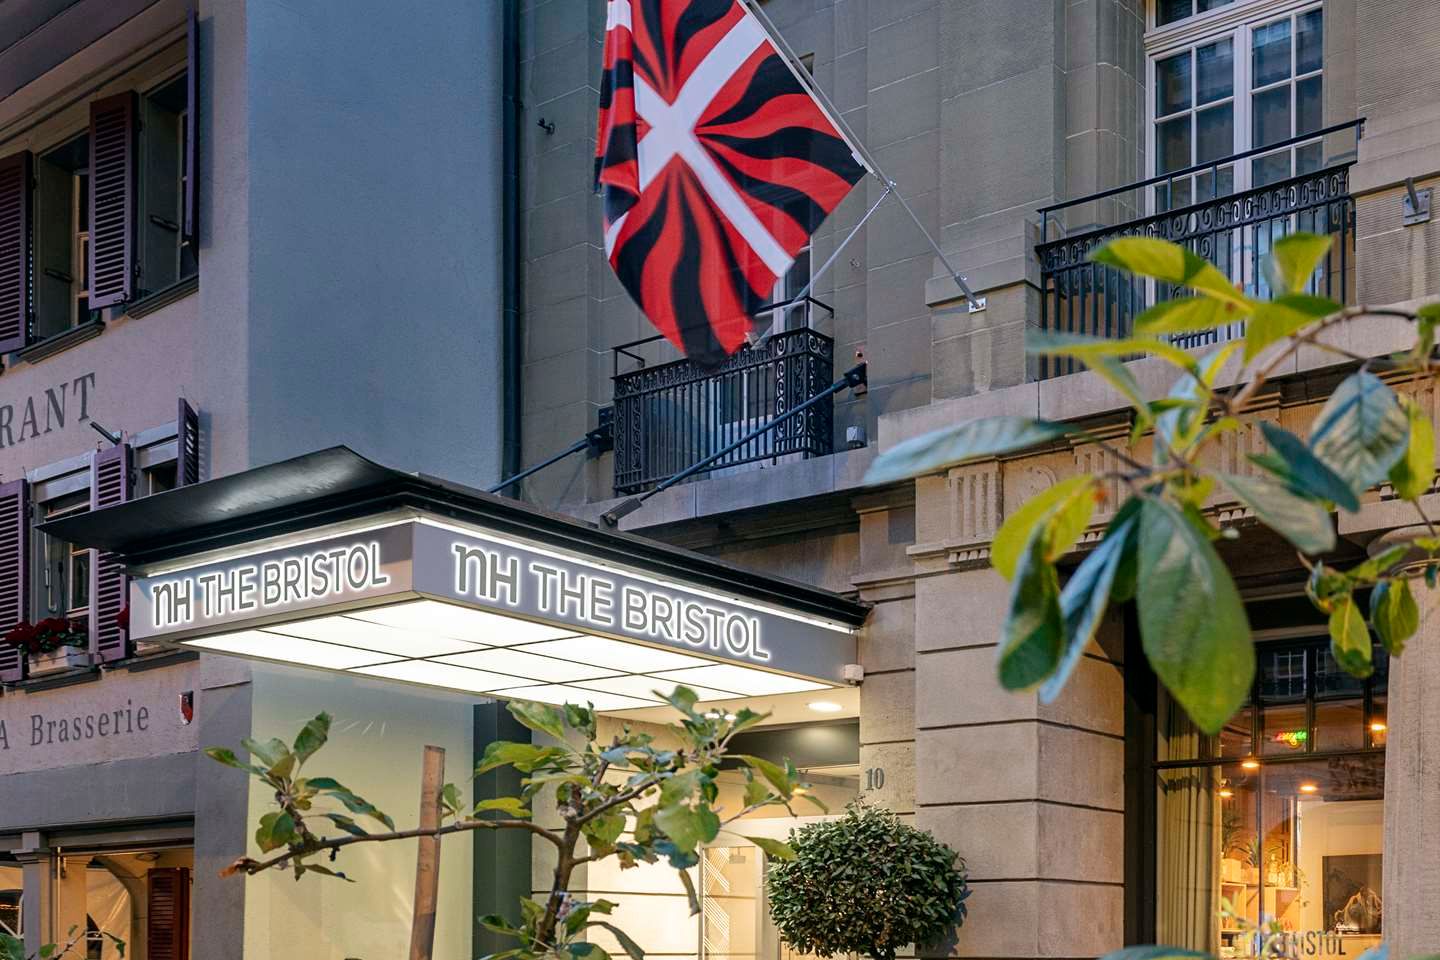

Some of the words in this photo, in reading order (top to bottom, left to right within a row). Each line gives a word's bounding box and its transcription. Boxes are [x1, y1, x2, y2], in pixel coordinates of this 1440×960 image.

[199, 567, 255, 616] THE
[263, 543, 388, 605] BRISTOL
[532, 563, 614, 625] THE
[624, 587, 769, 660] BRISTOL
[30, 699, 149, 746] Brasserie
[864, 767, 885, 791] 10
